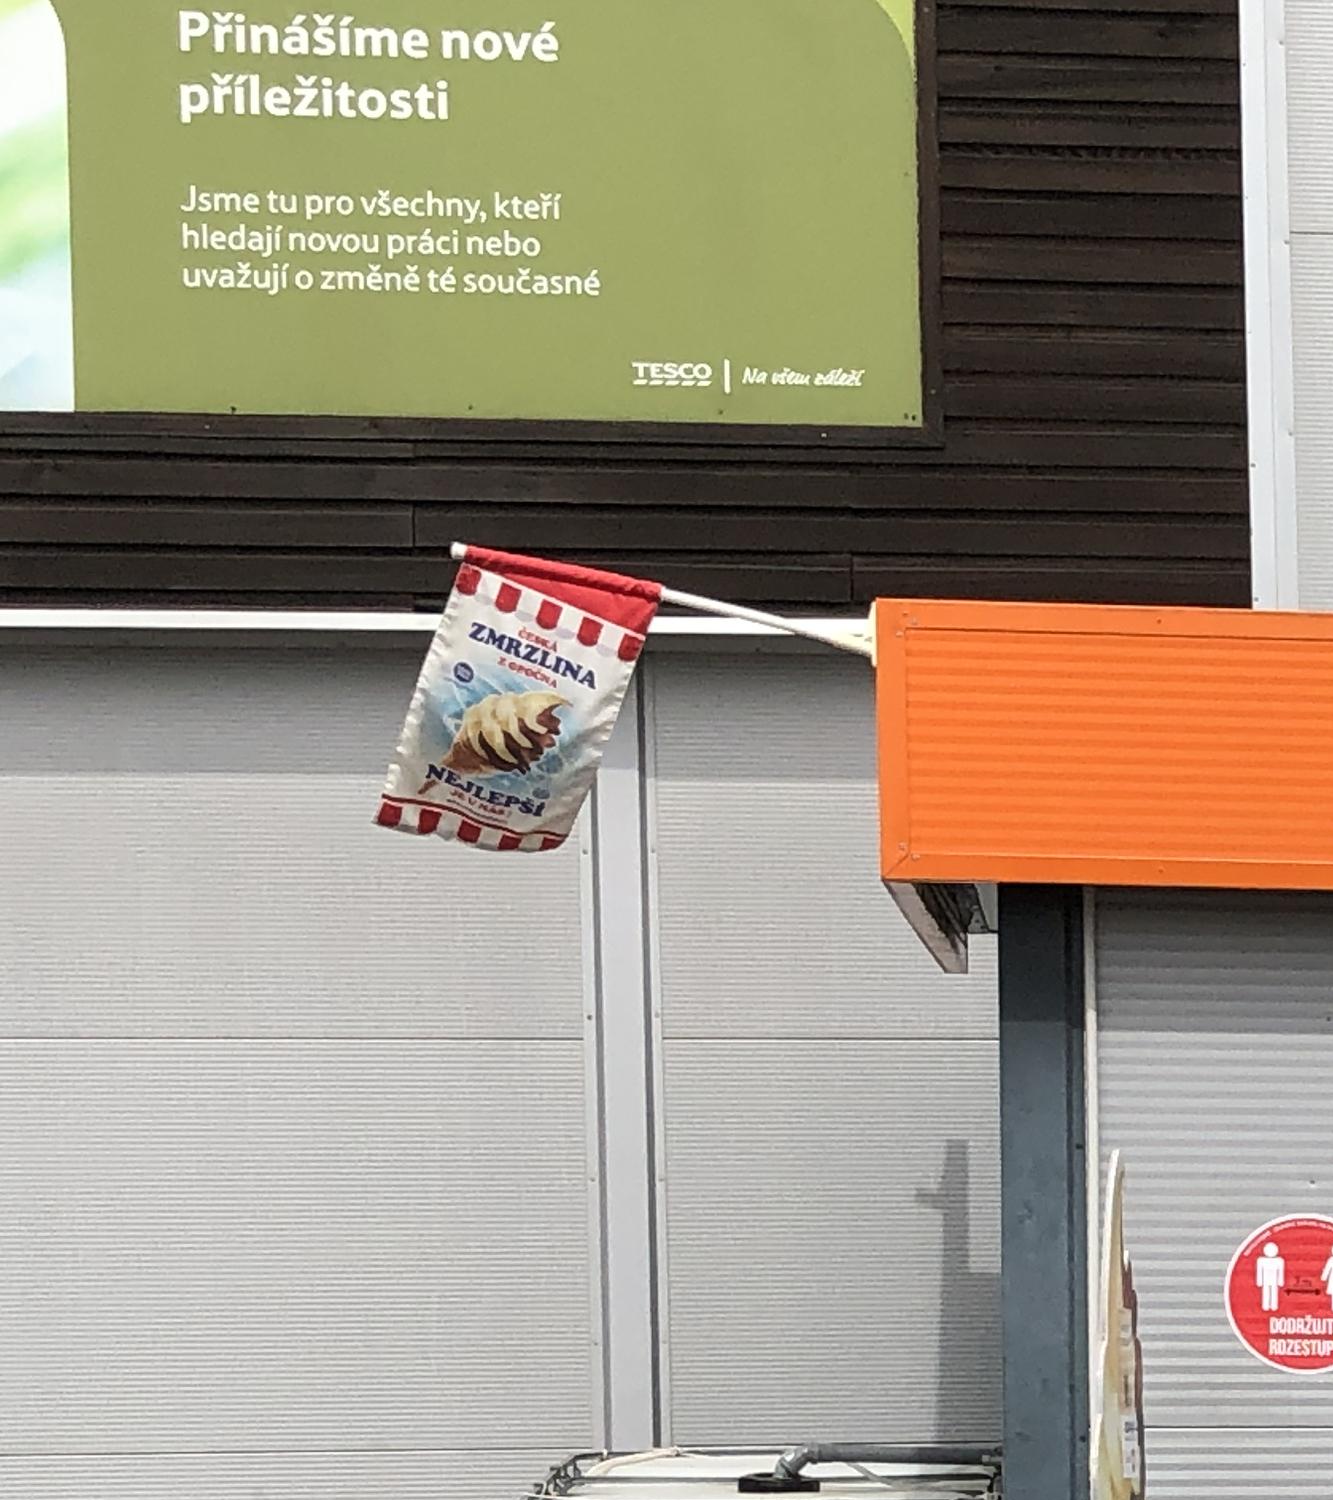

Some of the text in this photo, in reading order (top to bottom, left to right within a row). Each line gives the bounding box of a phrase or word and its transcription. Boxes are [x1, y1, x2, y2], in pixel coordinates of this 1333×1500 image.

[178, 10, 560, 62] Přinášíme nové
[179, 73, 450, 124] příležitosti
[180, 185, 562, 224] Jsme tu pro všechny, kteří
[181, 223, 542, 259] hledají novou práci nebo
[182, 262, 601, 297] uvažují o změně té současné
[631, 362, 713, 382] TESCO
[741, 366, 768, 385] Na
[771, 367, 812, 386] všem
[468, 621, 597, 690] ZMRZLINA
[425, 763, 546, 818] NEJLEPŠÍ
